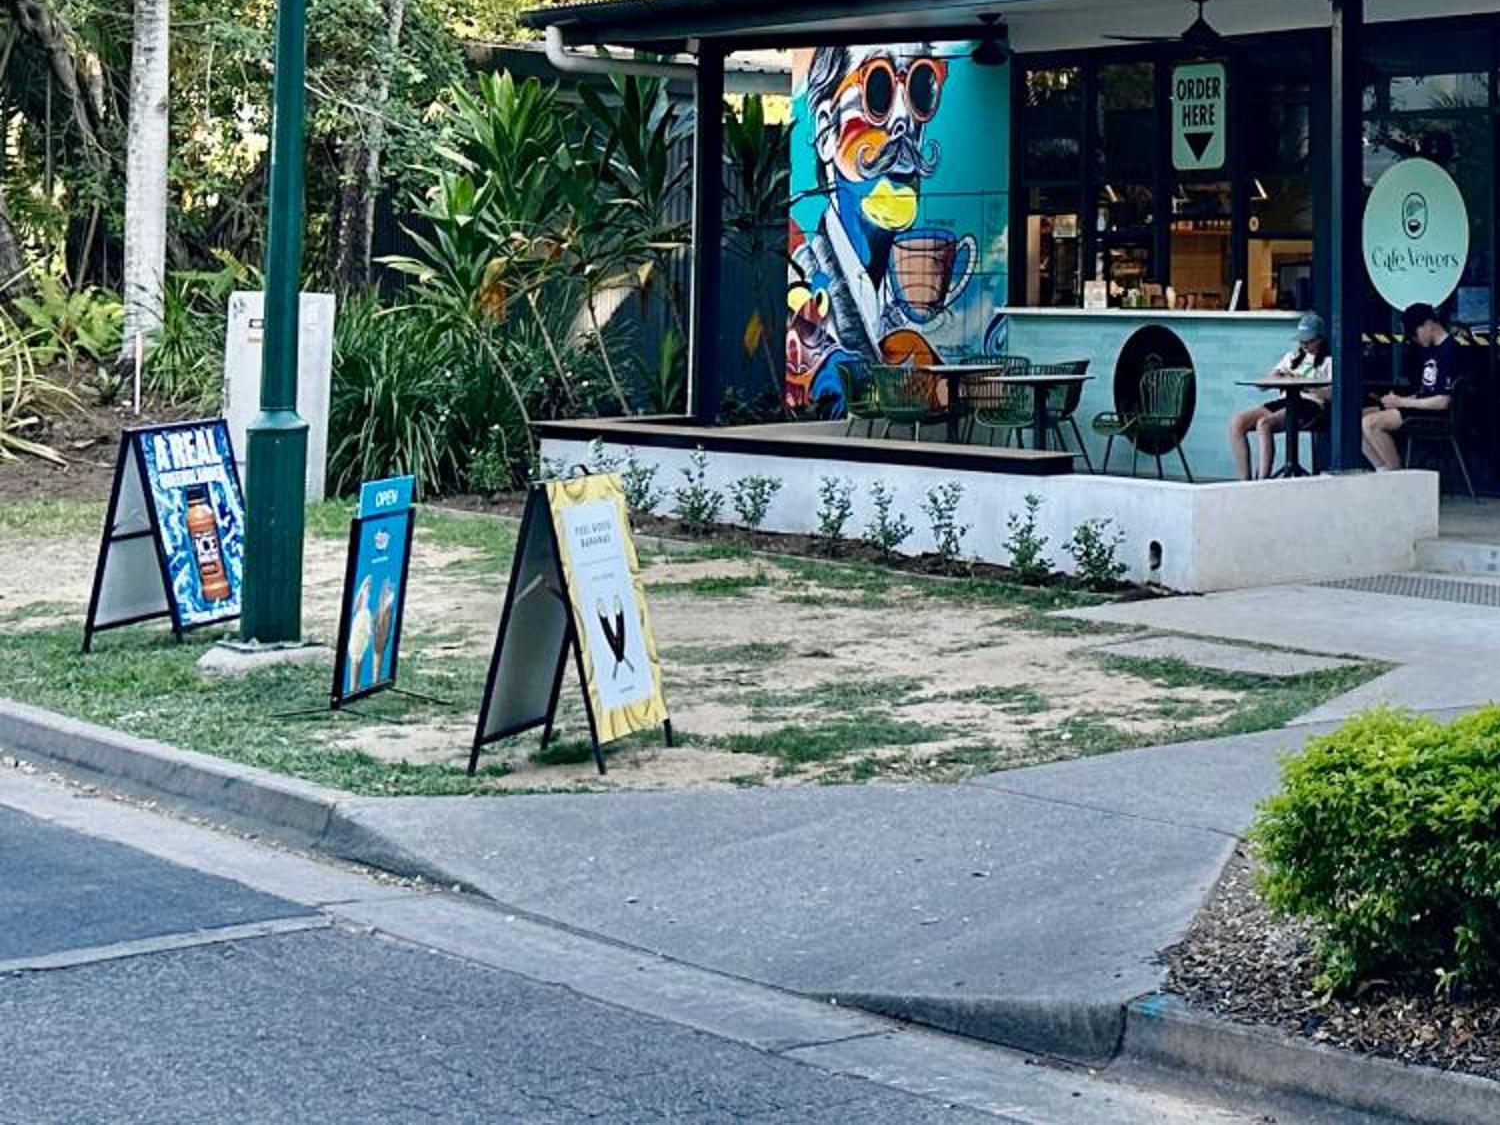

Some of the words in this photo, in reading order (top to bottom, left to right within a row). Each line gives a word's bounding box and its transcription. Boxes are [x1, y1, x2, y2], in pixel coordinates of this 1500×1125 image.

[1177, 77, 1221, 101] ORDER
[1182, 104, 1216, 127] HERE
[1371, 247, 1408, 273] Cafe
[153, 434, 173, 472] A
[168, 427, 223, 470] REAL
[375, 488, 399, 508] OPEN
[194, 535, 219, 557] ICE
